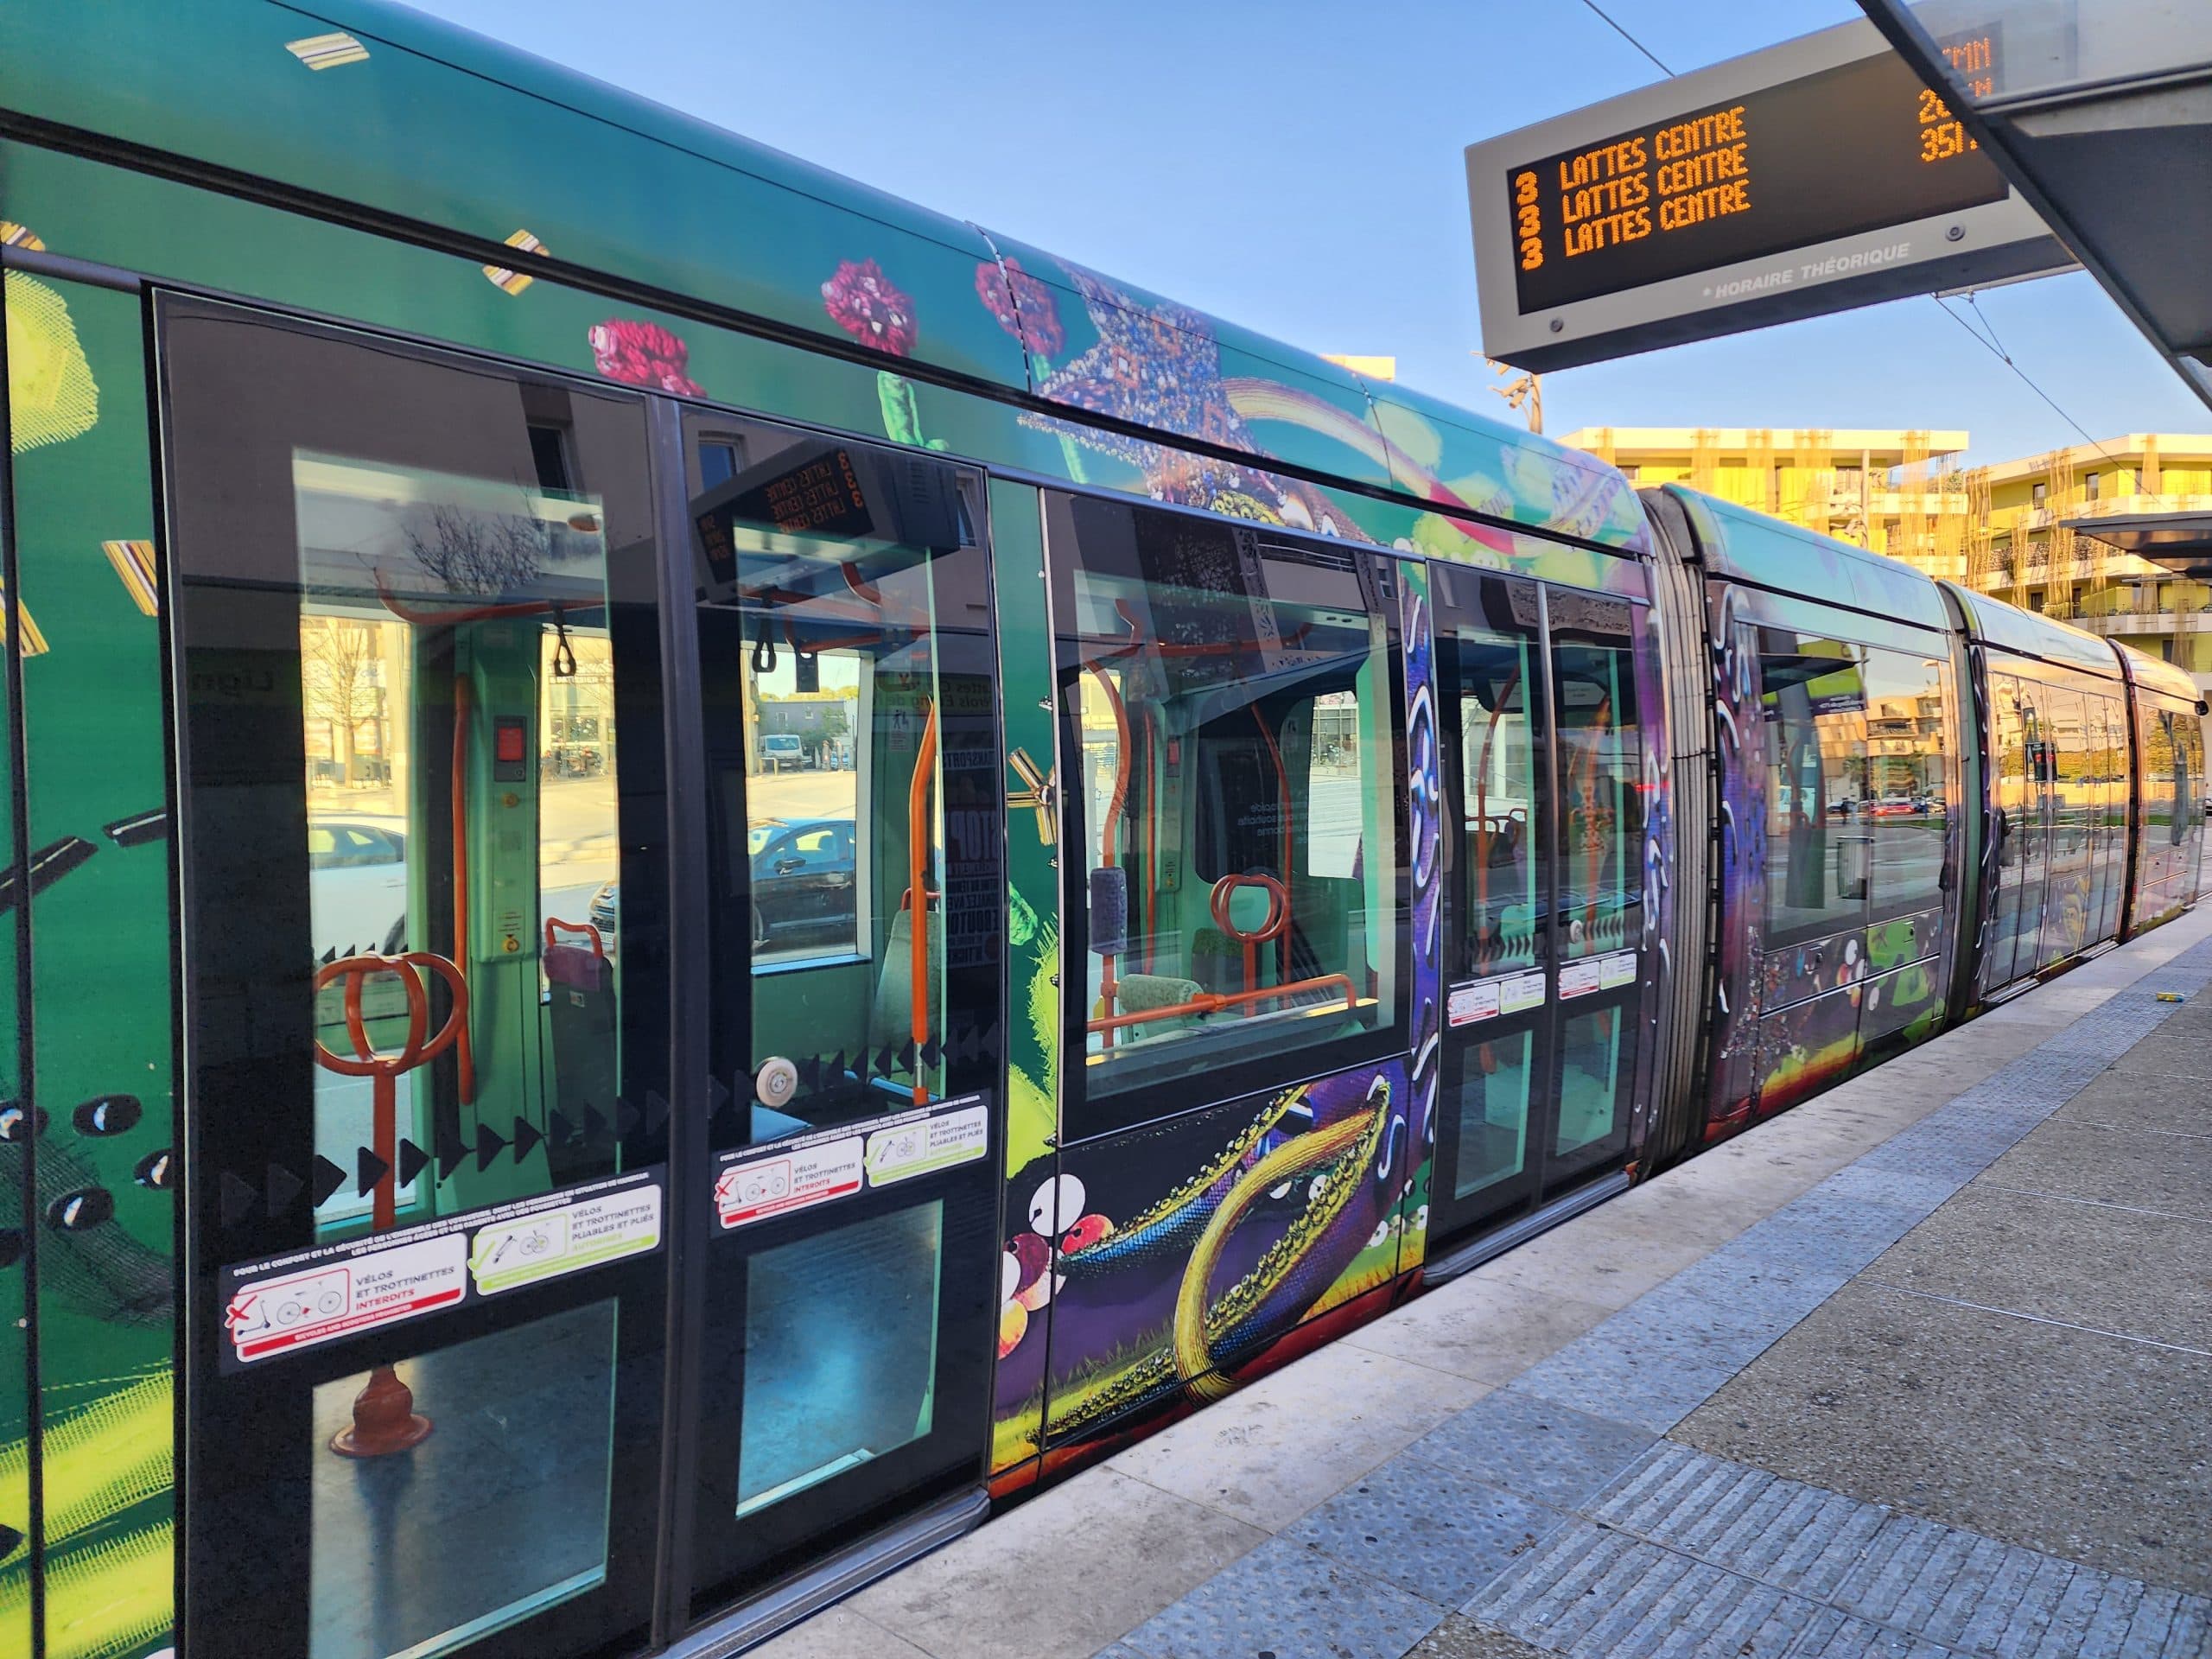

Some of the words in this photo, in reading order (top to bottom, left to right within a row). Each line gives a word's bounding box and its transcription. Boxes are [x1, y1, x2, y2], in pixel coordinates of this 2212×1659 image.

[1516, 171, 1538, 206] 3
[1560, 137, 1648, 190] LATTES
[1655, 105, 1746, 161] CENTRE
[1518, 205, 1541, 238] 3
[1561, 171, 1649, 224] LATTES
[1657, 142, 1749, 196] CENTRE
[1521, 236, 1544, 270] 3
[1565, 206, 1652, 257] LATTES
[1659, 179, 1751, 231] CENTRE
[1714, 269, 1794, 299] HORAIRE
[1801, 242, 1911, 279] THÉORIQUE
[572, 1205, 601, 1218] VÉLOS
[572, 1220, 582, 1230] ET
[587, 1204, 650, 1226] TROTTINETTES
[572, 1224, 613, 1241] PLIABLES
[616, 1219, 627, 1229] ET
[629, 1213, 654, 1225] PLIÉS
[356, 1269, 393, 1286] VÉLOS
[356, 1287, 369, 1299] ET
[374, 1266, 454, 1294] TROTTINETTES
[356, 1287, 415, 1310] INTERDITS
